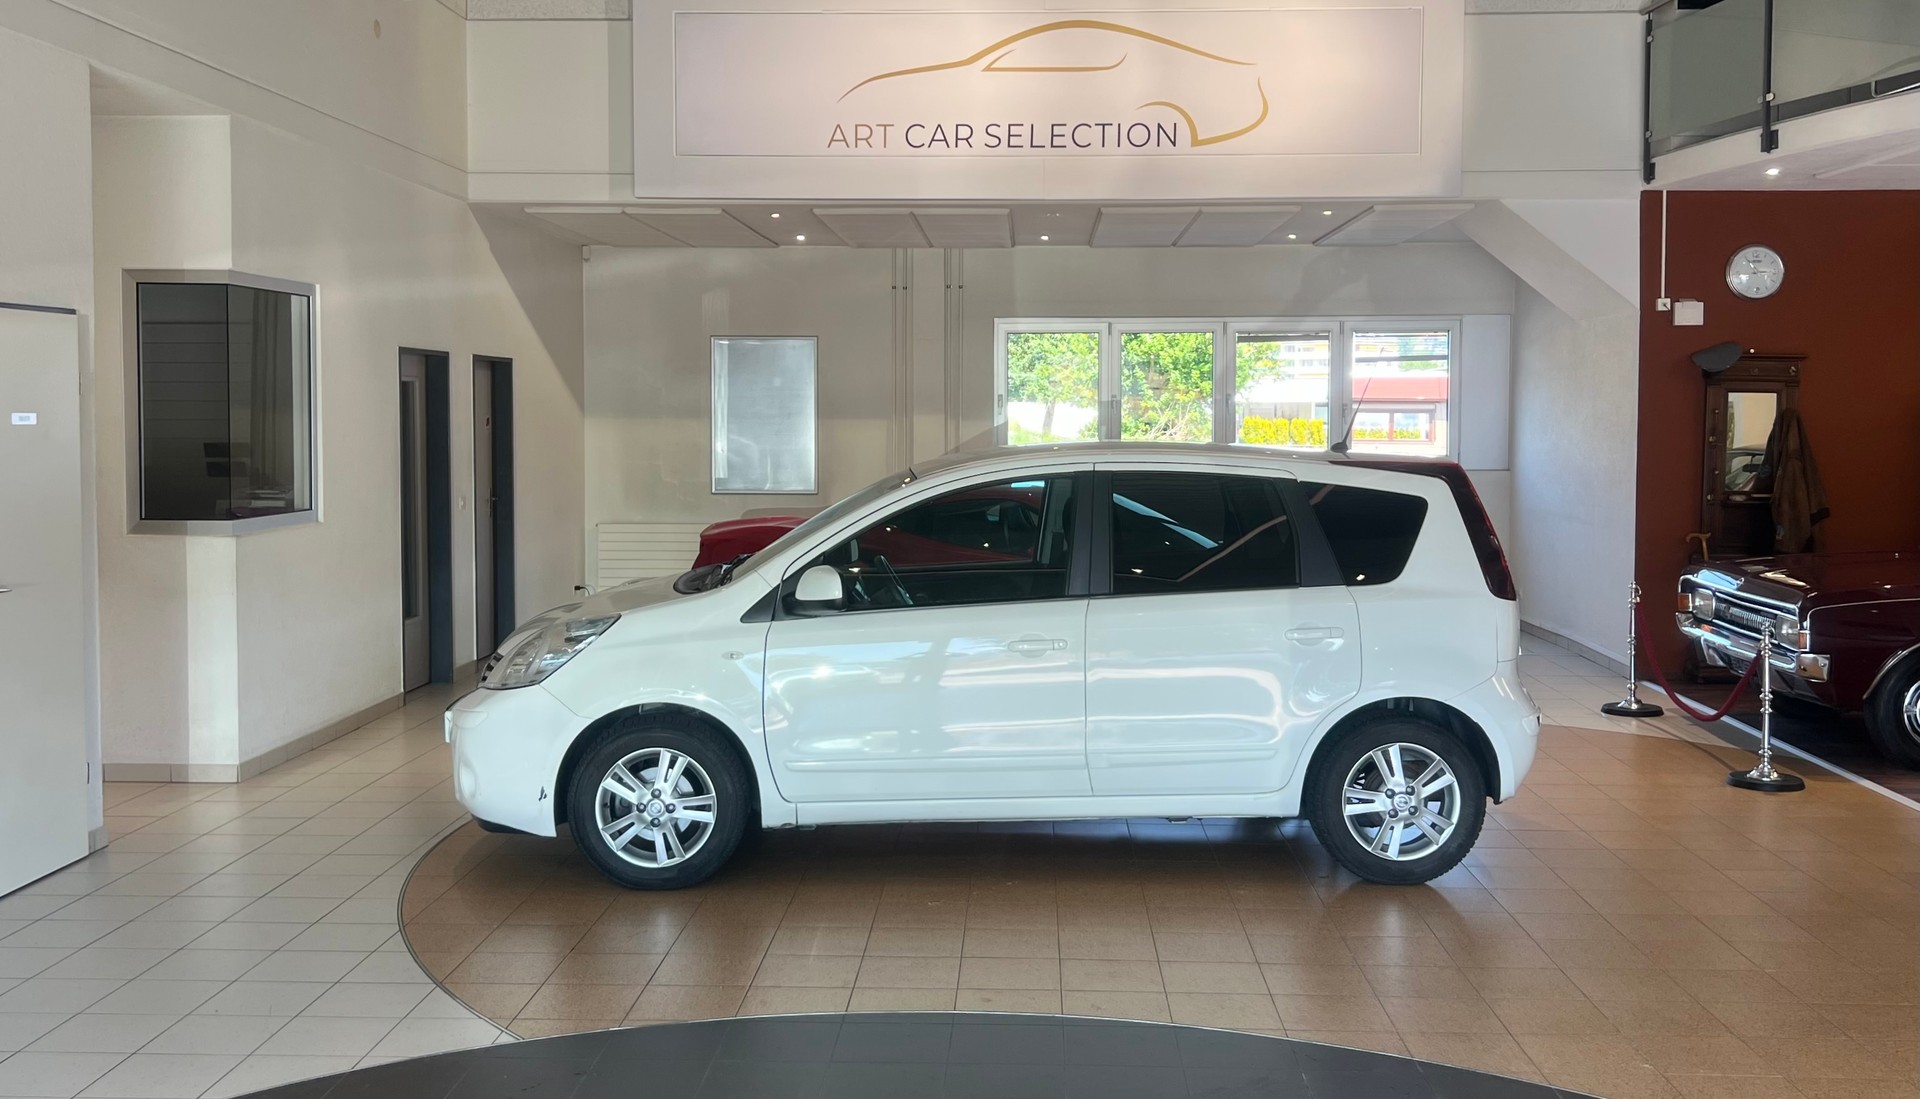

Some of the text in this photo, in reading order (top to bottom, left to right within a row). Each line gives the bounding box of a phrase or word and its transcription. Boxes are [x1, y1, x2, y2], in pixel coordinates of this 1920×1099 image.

[827, 122, 1178, 149] ART CAR SELECTION
